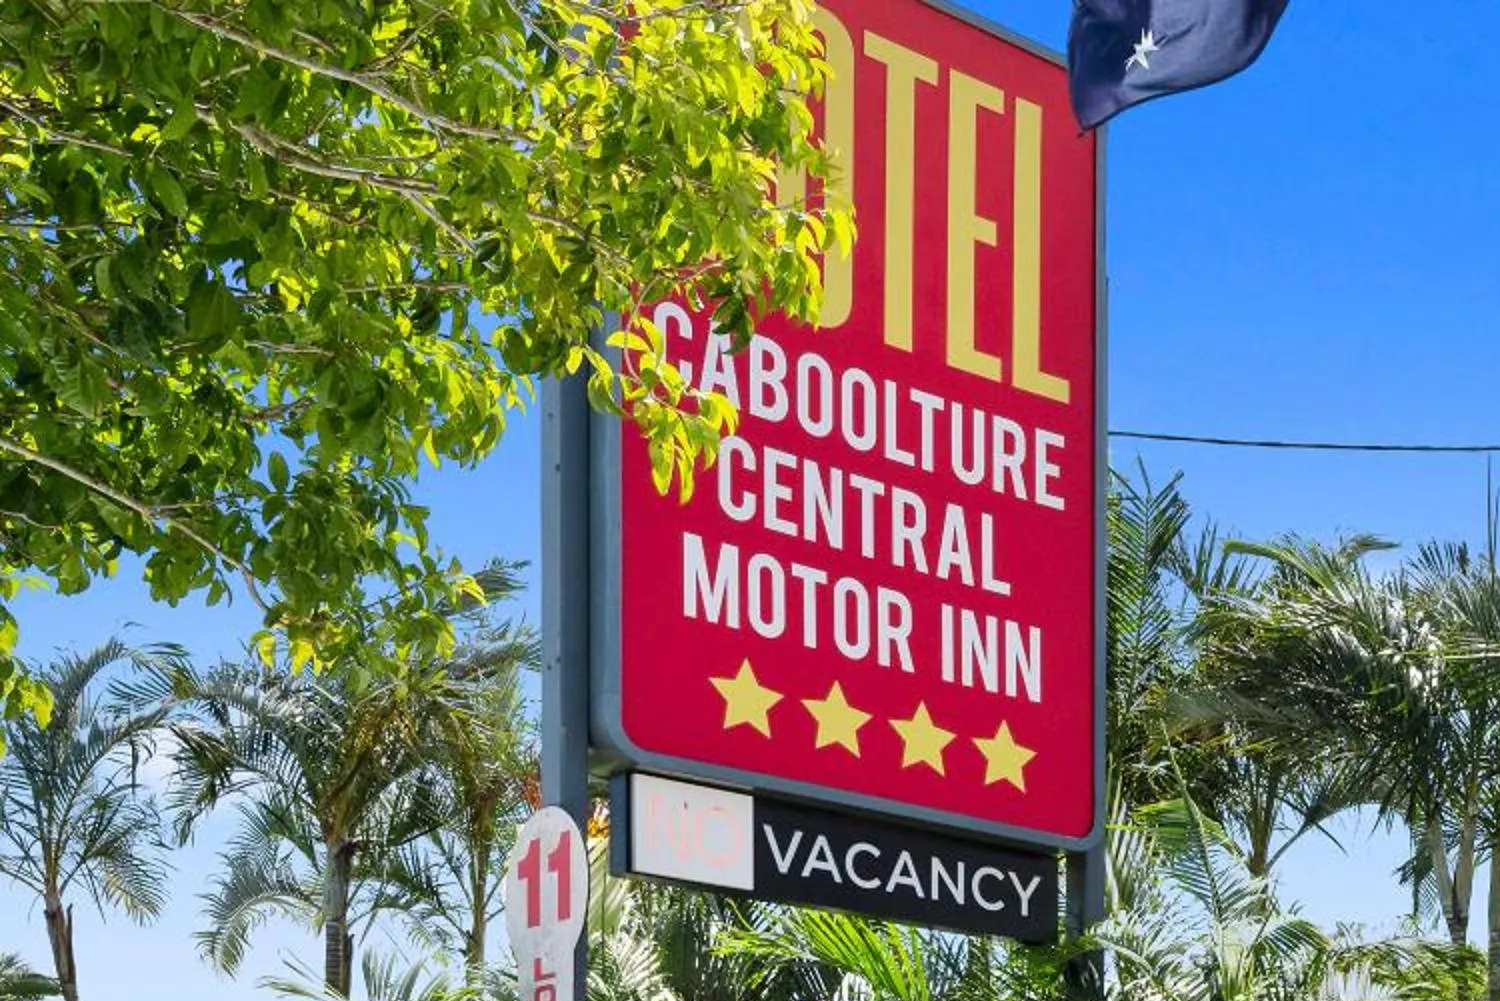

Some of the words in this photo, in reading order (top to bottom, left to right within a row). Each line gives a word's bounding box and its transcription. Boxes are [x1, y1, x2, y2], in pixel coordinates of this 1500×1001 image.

[775, 3, 1070, 404] OTEL
[653, 302, 1065, 511] CABOOLTURE
[717, 436, 1011, 597] CENTRAL
[682, 531, 915, 674] MOTOR
[941, 604, 1043, 703] INN
[517, 830, 571, 929] 11
[645, 792, 744, 870] NO
[762, 823, 1042, 918] VACANCY
